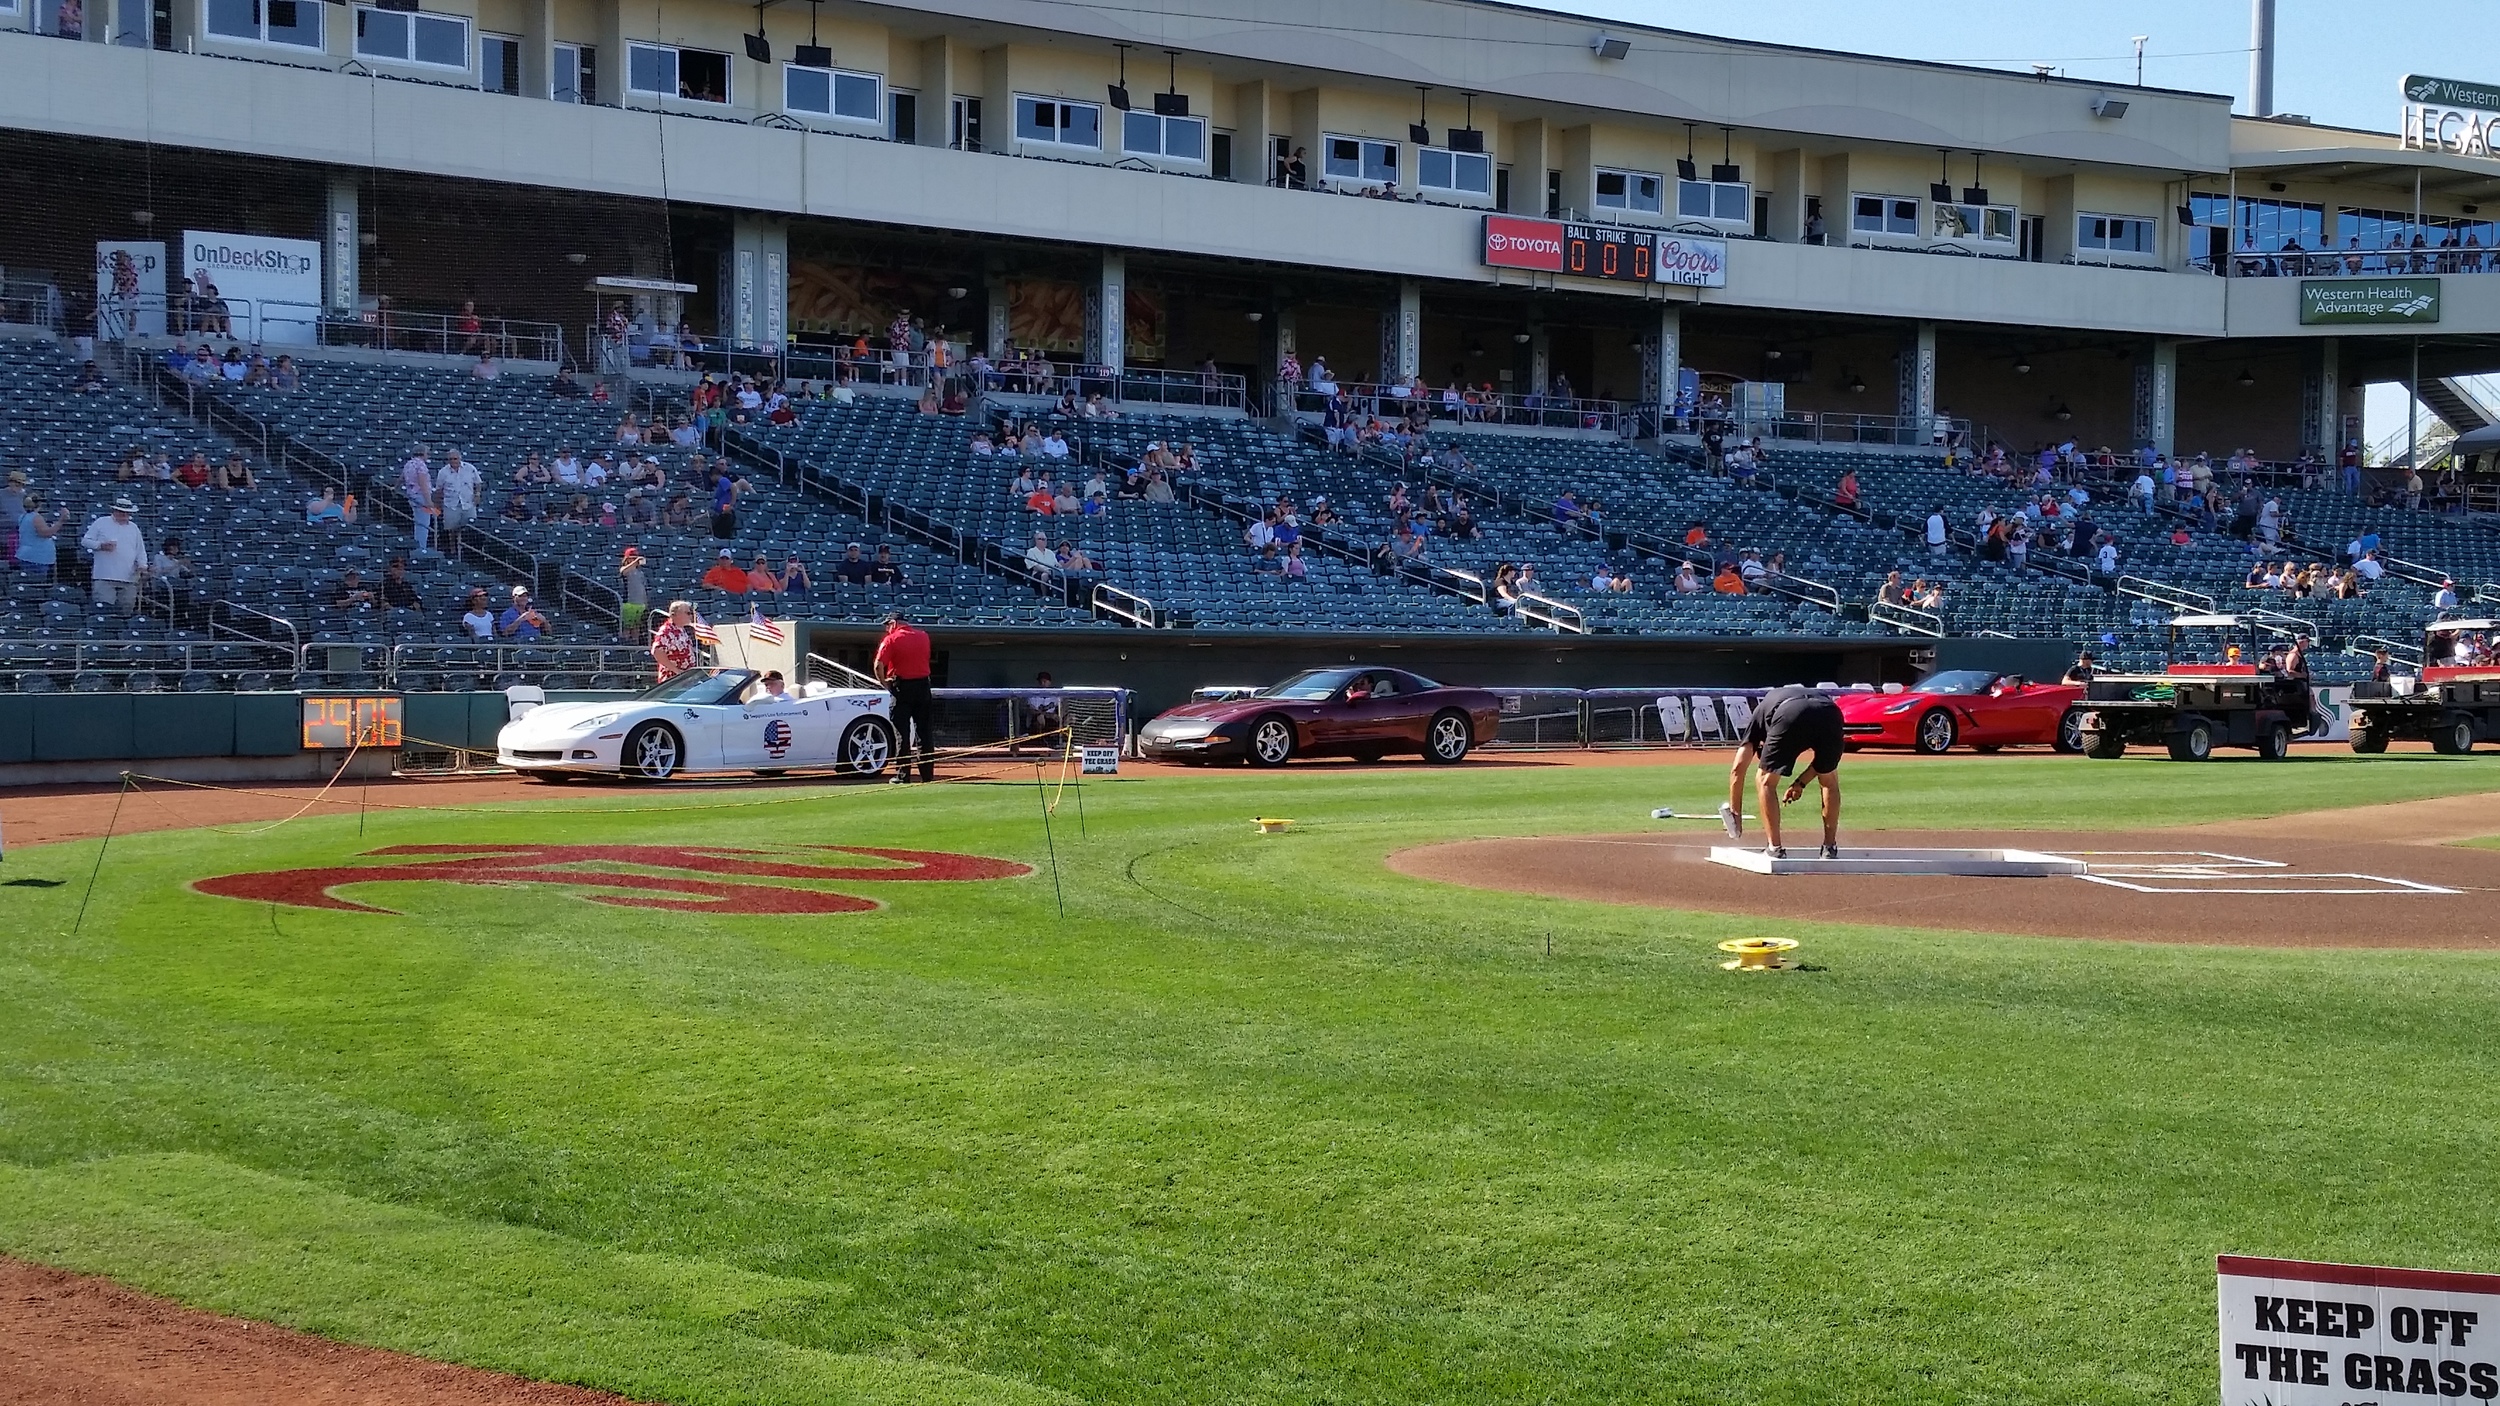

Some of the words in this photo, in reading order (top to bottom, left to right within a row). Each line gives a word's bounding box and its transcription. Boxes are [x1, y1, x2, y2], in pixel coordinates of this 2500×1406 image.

[2442, 82, 2498, 106] Western
[1509, 236, 1561, 255] TOYOTA
[1567, 226, 1590, 240] BALL
[1595, 229, 1627, 244] STRIKE
[1633, 232, 1652, 247] OUT
[193, 243, 311, 273] OnDeckShop
[1660, 240, 1720, 273] Coors
[1671, 270, 1709, 286] LIGHT
[2305, 287, 2364, 300] Western
[2367, 286, 2413, 299] Health
[363, 314, 377, 323] 117
[2314, 300, 2384, 316] Advantage
[2254, 1296, 2375, 1339] KEEP
[2390, 1306, 2478, 1347] OFF
[2235, 1343, 2329, 1387] THE
[2344, 1352, 2499, 1400] GRASS
